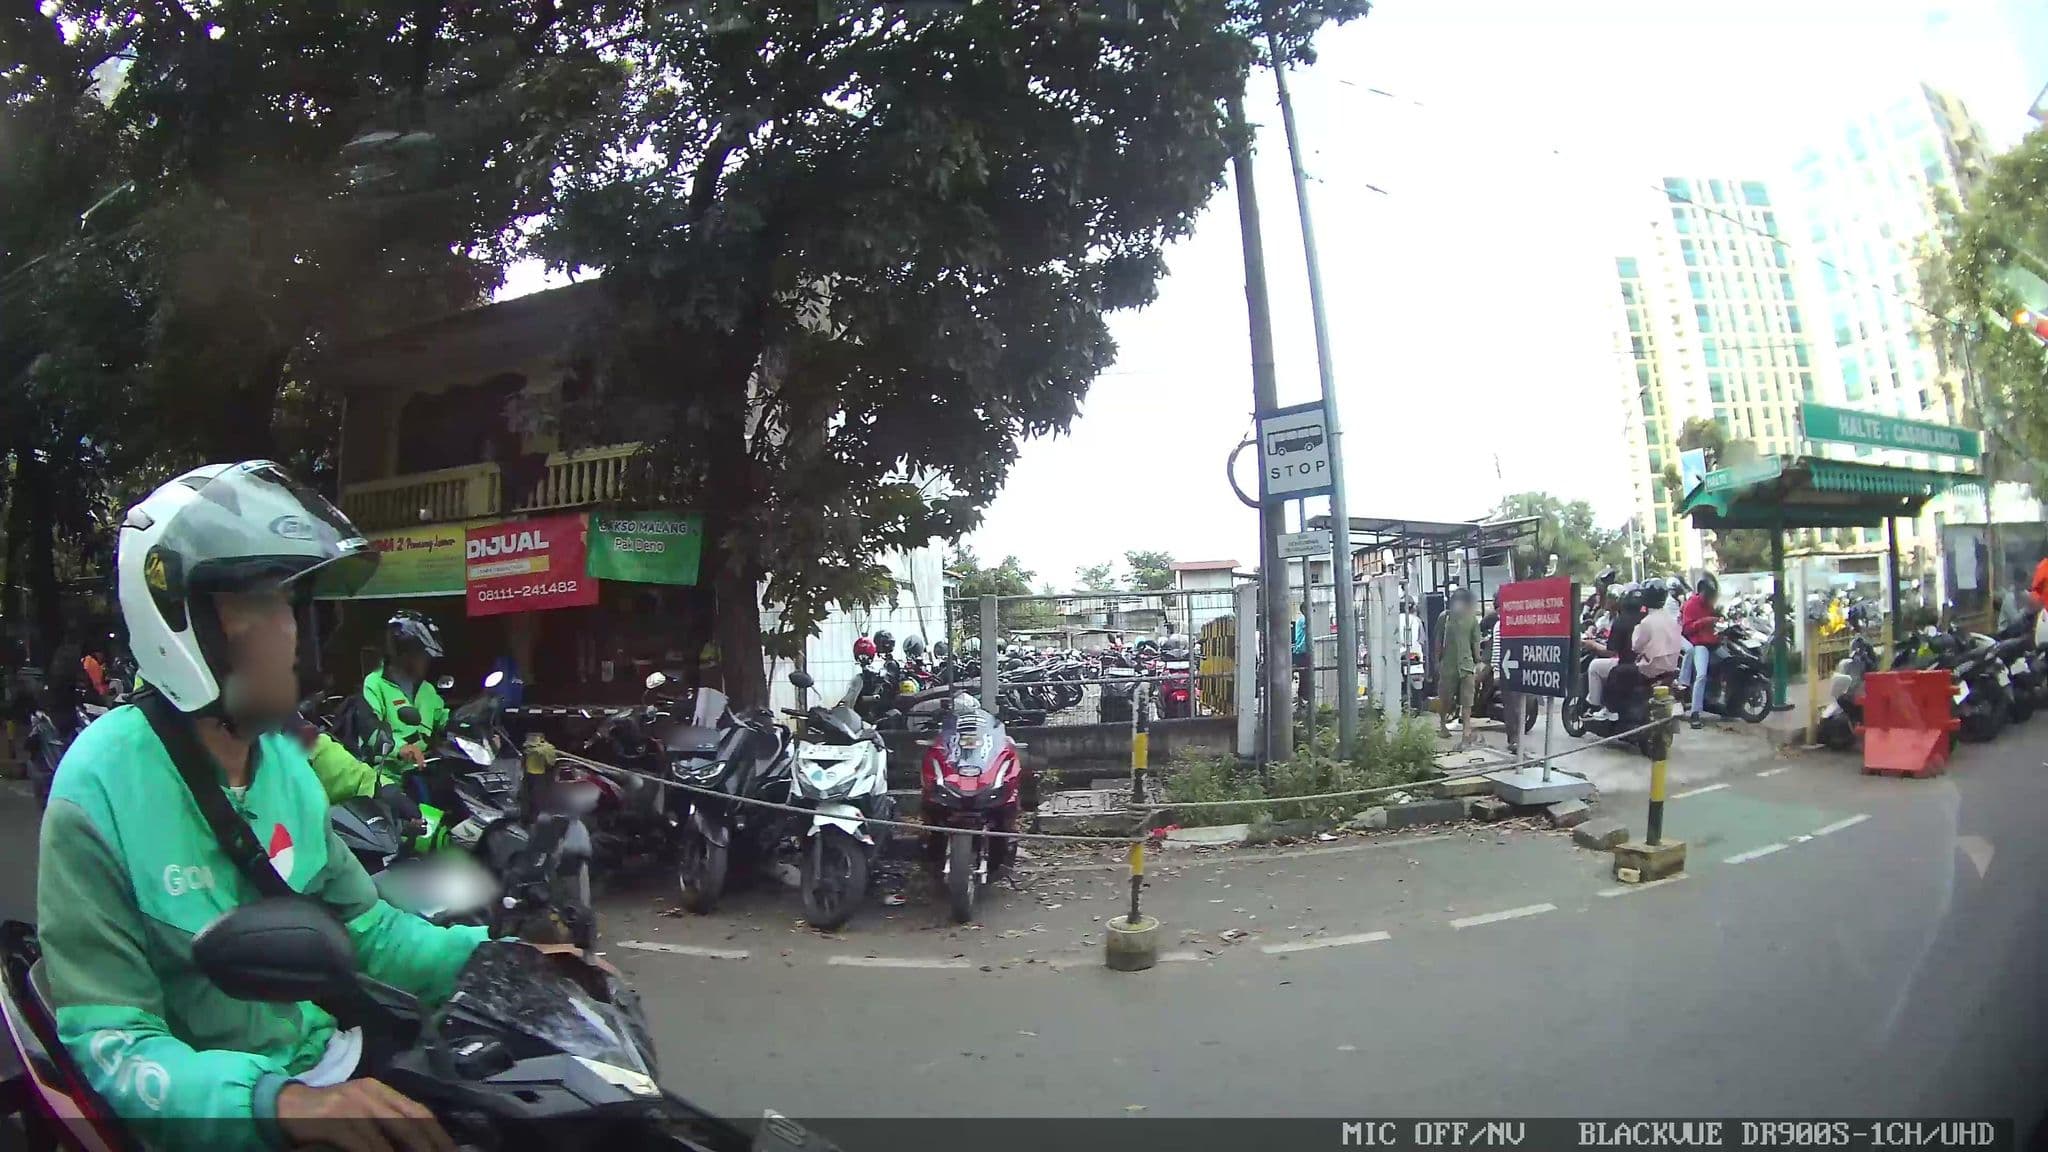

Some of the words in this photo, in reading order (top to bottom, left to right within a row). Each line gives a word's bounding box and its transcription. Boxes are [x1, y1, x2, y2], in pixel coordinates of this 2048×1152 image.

[1838, 414, 1882, 439] HALTE
[1271, 460, 1325, 479] STOP
[638, 520, 688, 535] MALANG
[466, 530, 549, 559] DIJUAL
[614, 536, 633, 552] Pak
[478, 580, 577, 602] 08111-241482
[1522, 645, 1561, 663] PARKIR
[1522, 669, 1560, 689] MOTOR
